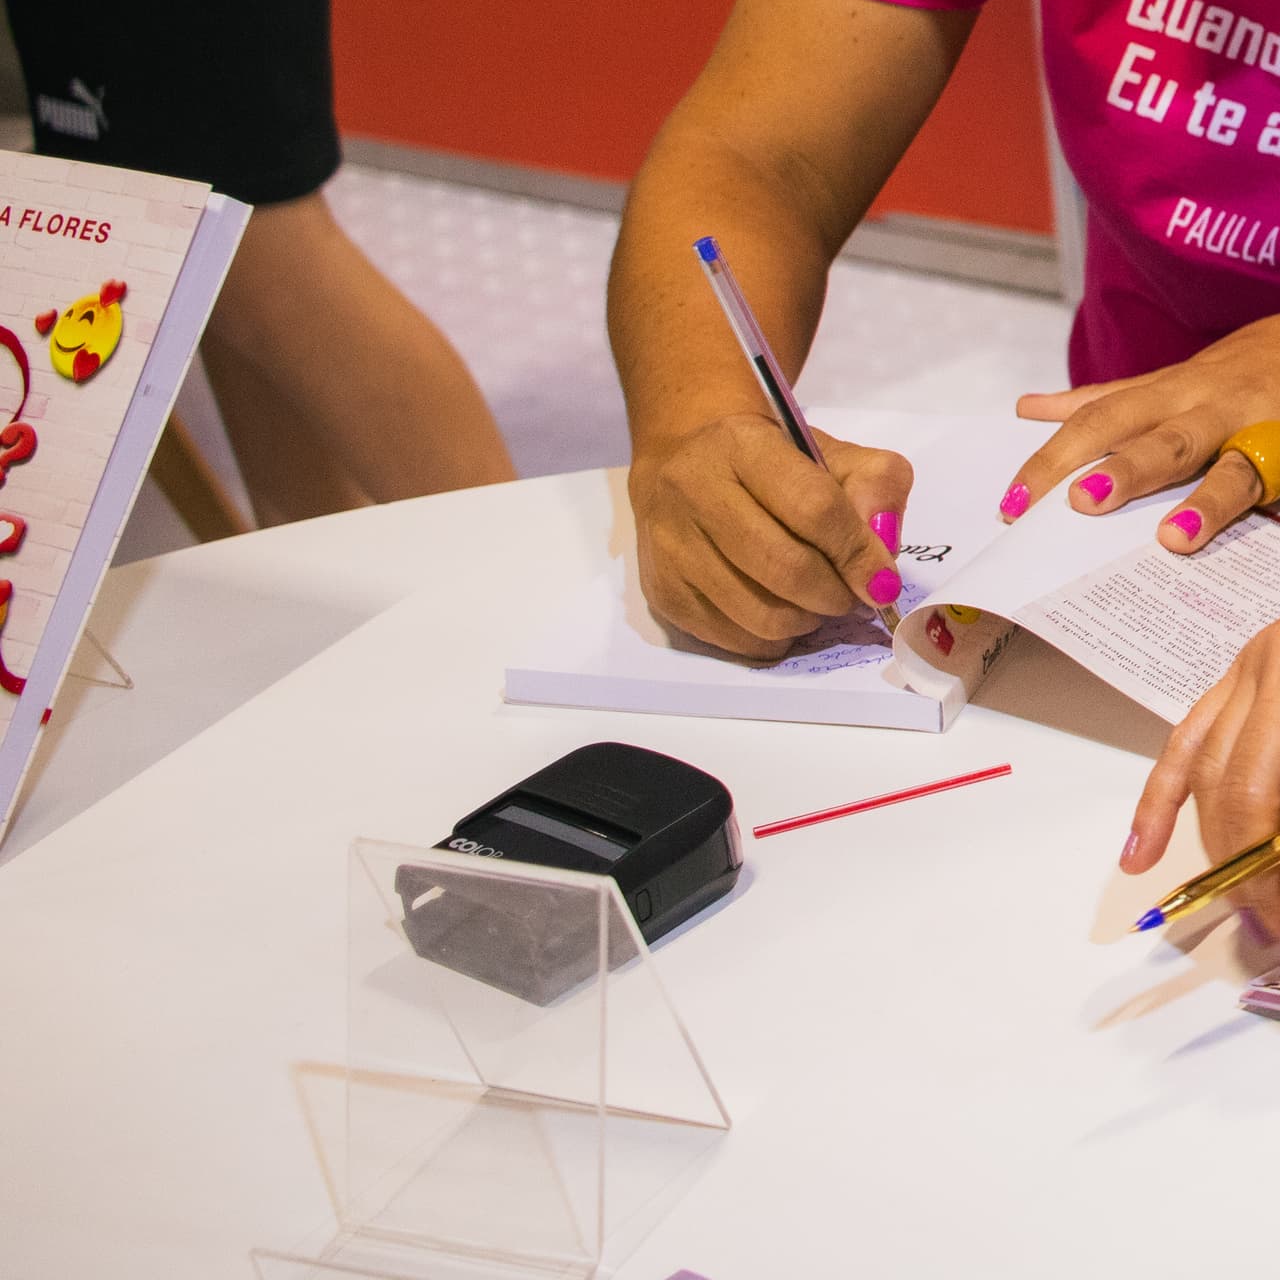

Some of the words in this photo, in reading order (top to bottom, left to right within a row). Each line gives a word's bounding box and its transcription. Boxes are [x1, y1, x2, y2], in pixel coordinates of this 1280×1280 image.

[1106, 41, 1178, 123] Eu
[1184, 80, 1247, 146] te
[18, 208, 112, 244] FLORES
[1166, 196, 1280, 265] PAULLA
